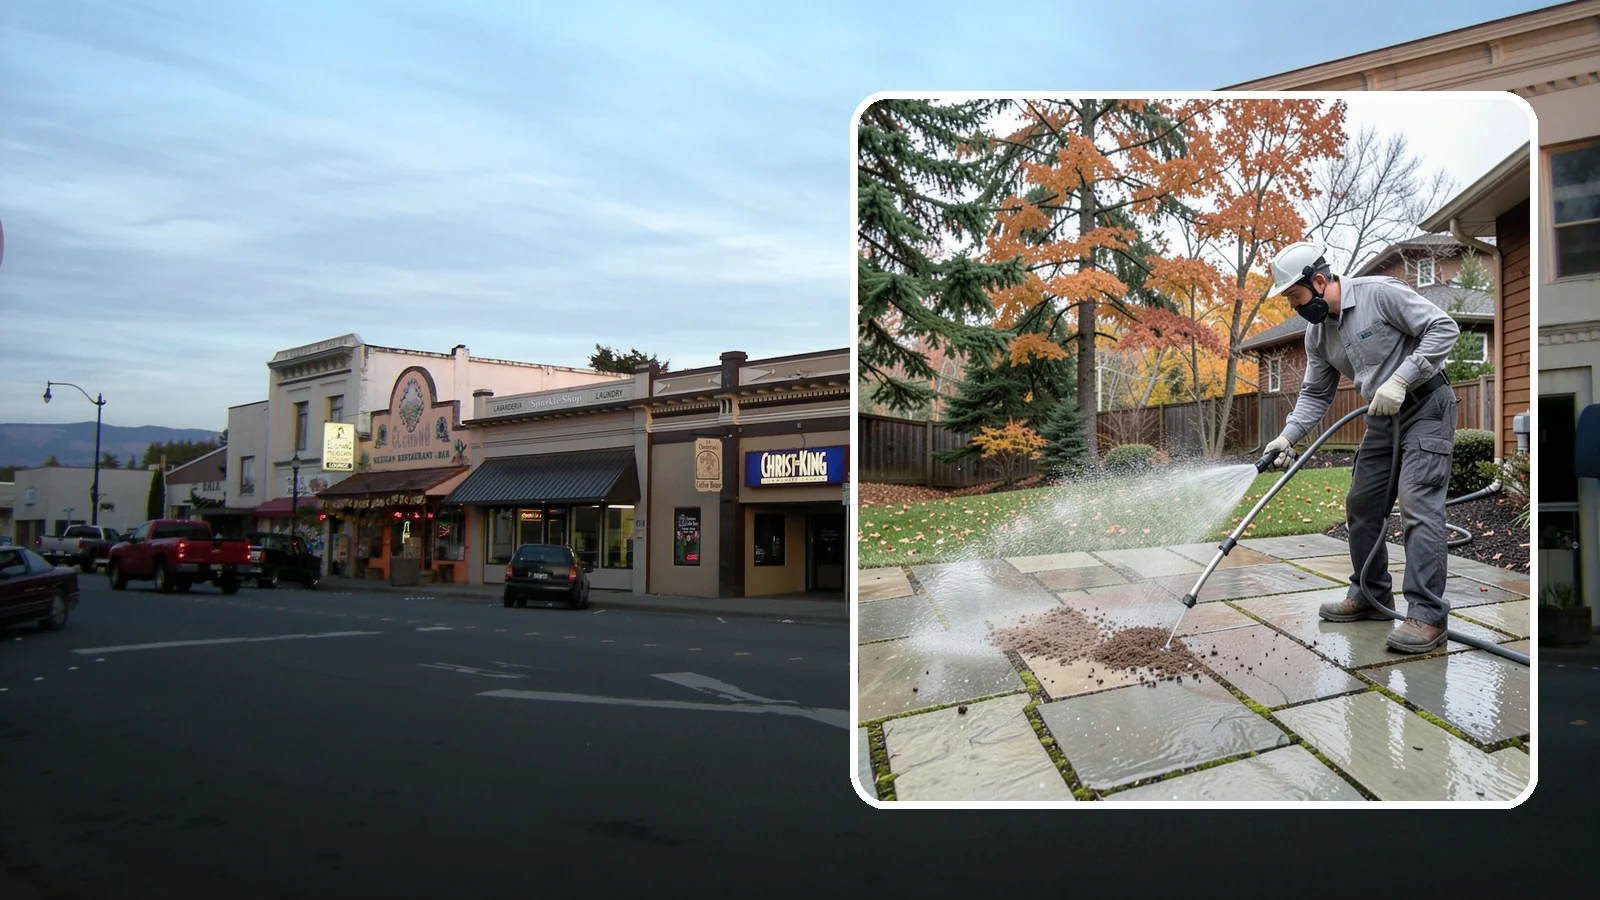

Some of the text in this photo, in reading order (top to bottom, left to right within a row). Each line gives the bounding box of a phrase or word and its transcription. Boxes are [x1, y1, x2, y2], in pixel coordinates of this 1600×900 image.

[493, 389, 623, 412] LAVANDERIA Sparkle Shop LAUNDRY
[374, 454, 396, 464] MEXICAN
[397, 451, 433, 462] RESTAURANT
[438, 450, 450, 459] BAR
[760, 450, 827, 477] CHRIST KING
